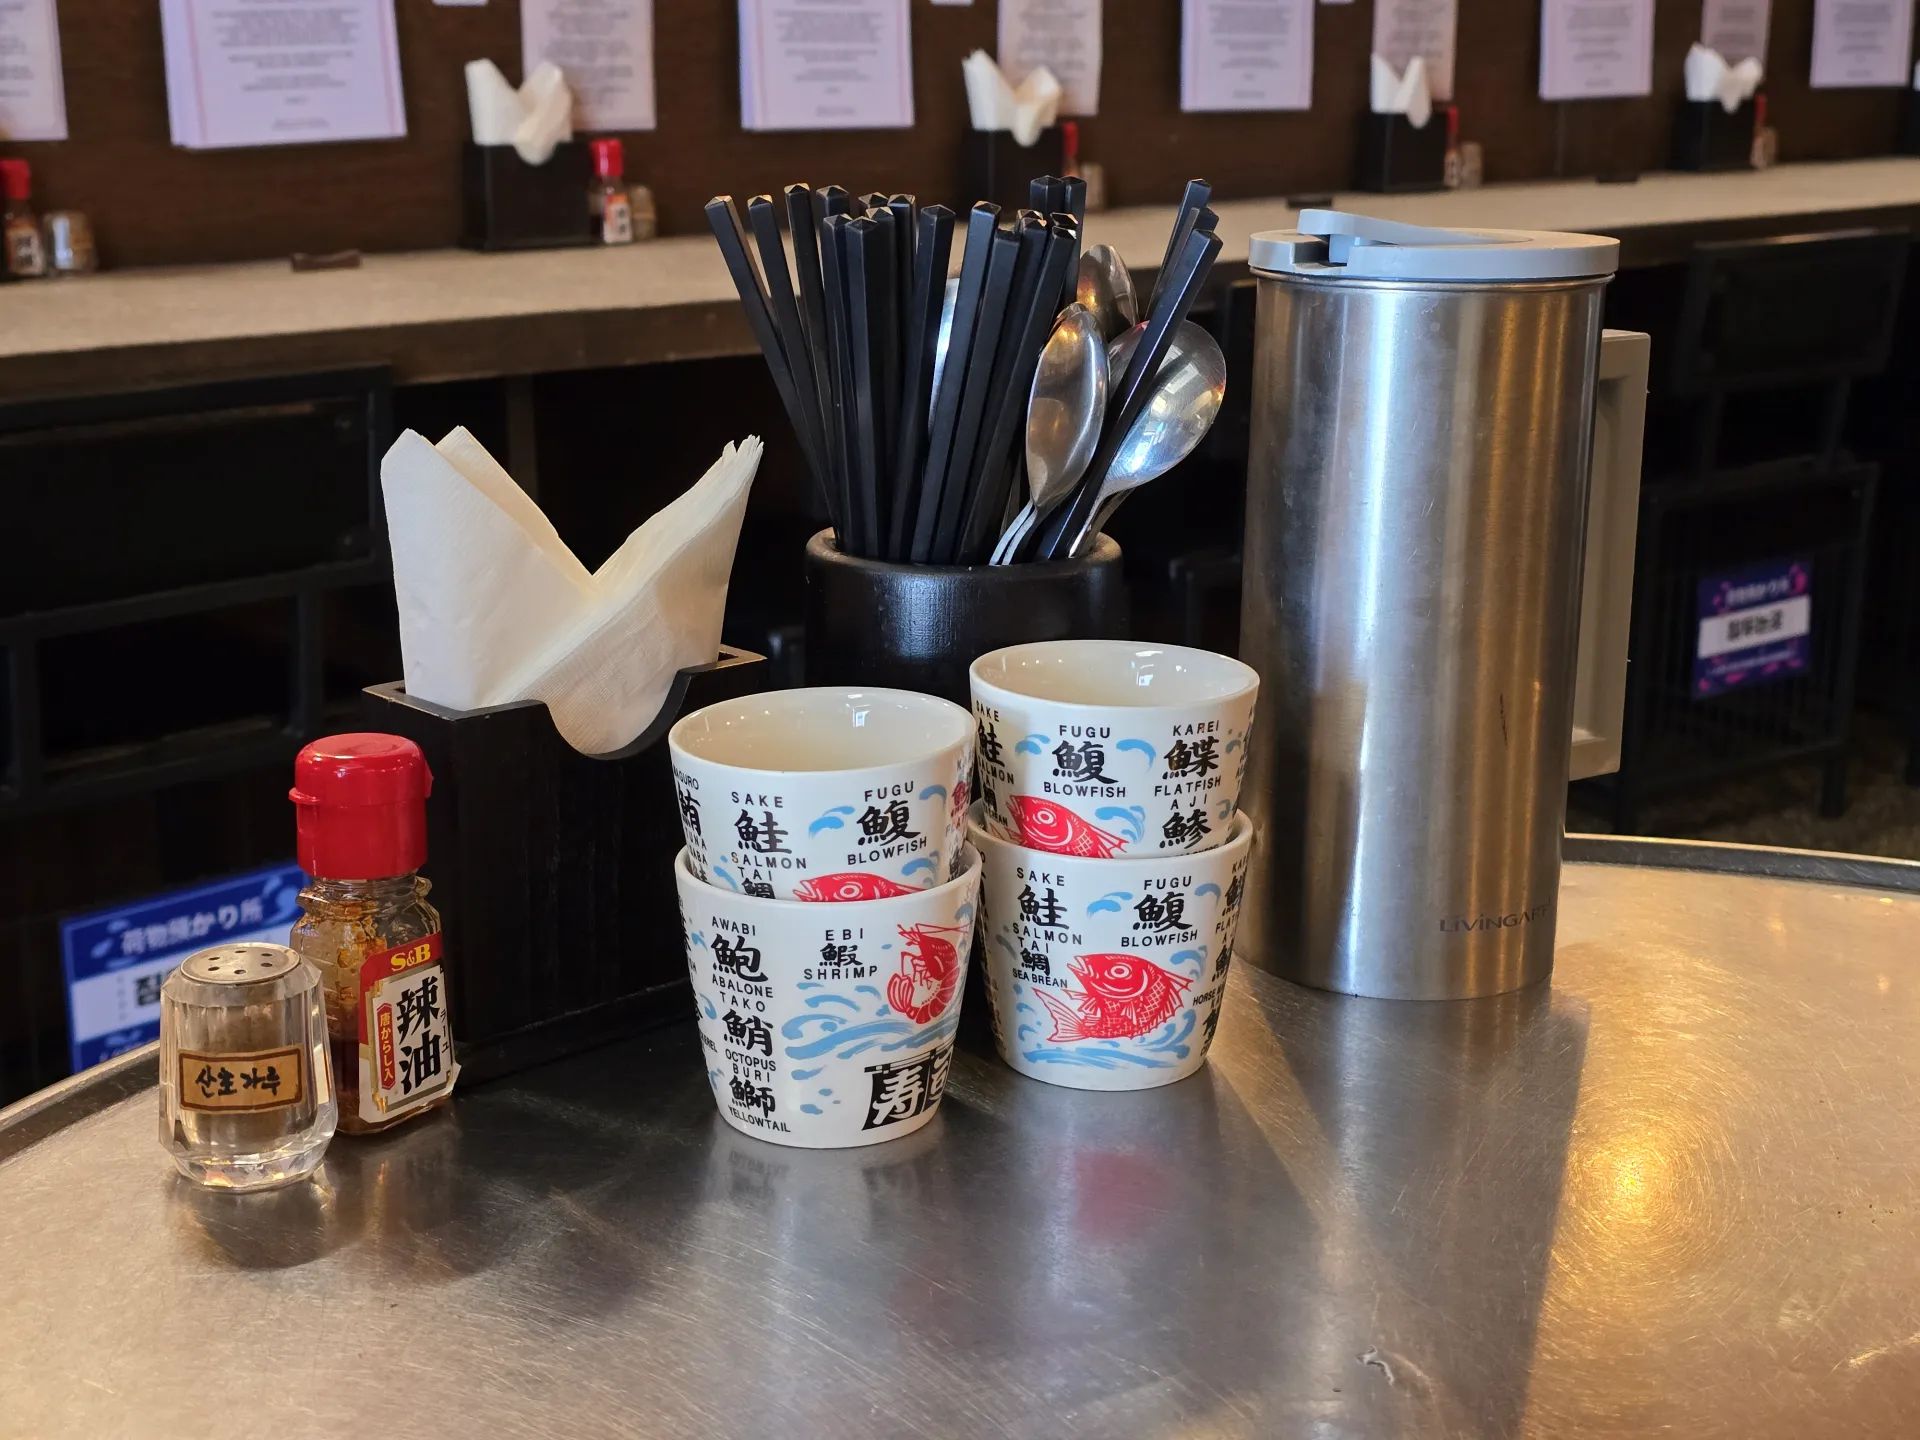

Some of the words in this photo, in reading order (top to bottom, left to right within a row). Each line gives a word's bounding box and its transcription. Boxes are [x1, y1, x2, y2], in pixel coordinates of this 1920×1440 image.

[1059, 725, 1111, 738] FUGU
[1173, 720, 1220, 737] KAREI
[864, 780, 915, 802] FUGU
[1043, 781, 1127, 798] BLOWFISH
[1154, 775, 1222, 797] FLATFISH
[731, 791, 784, 809] SAKE
[1170, 794, 1208, 811] AJI
[734, 809, 792, 854] 鮭
[731, 851, 807, 869] SALMON
[847, 836, 928, 866] BLOWFISH
[737, 866, 773, 882] TAI
[1017, 867, 1065, 887] SAKE
[1144, 875, 1192, 891] FUGU
[1017, 884, 1070, 930] 鮭
[711, 916, 756, 937] AWABI
[825, 927, 864, 941] EBI
[1012, 922, 1082, 946] SALMON
[1017, 936, 1049, 954] TAI
[1121, 929, 1198, 948] BLOWFISH
[390, 943, 431, 972] S&B
[710, 934, 769, 983] 鮑
[1020, 947, 1050, 976] 鯛
[803, 965, 878, 981] SHRIMP
[1012, 967, 1030, 982] SEA
[1031, 972, 1068, 989] BREAN
[711, 975, 774, 999] ABALONE
[1193, 988, 1217, 1006] HORSE
[719, 991, 766, 1012] TAKO
[396, 975, 441, 1095] 辣油
[379, 1012, 394, 1082] 唐からし入
[725, 1050, 777, 1072] OCTOPUS
[732, 1063, 770, 1083] BURI
[727, 1104, 791, 1133] YELLOWTAIL
